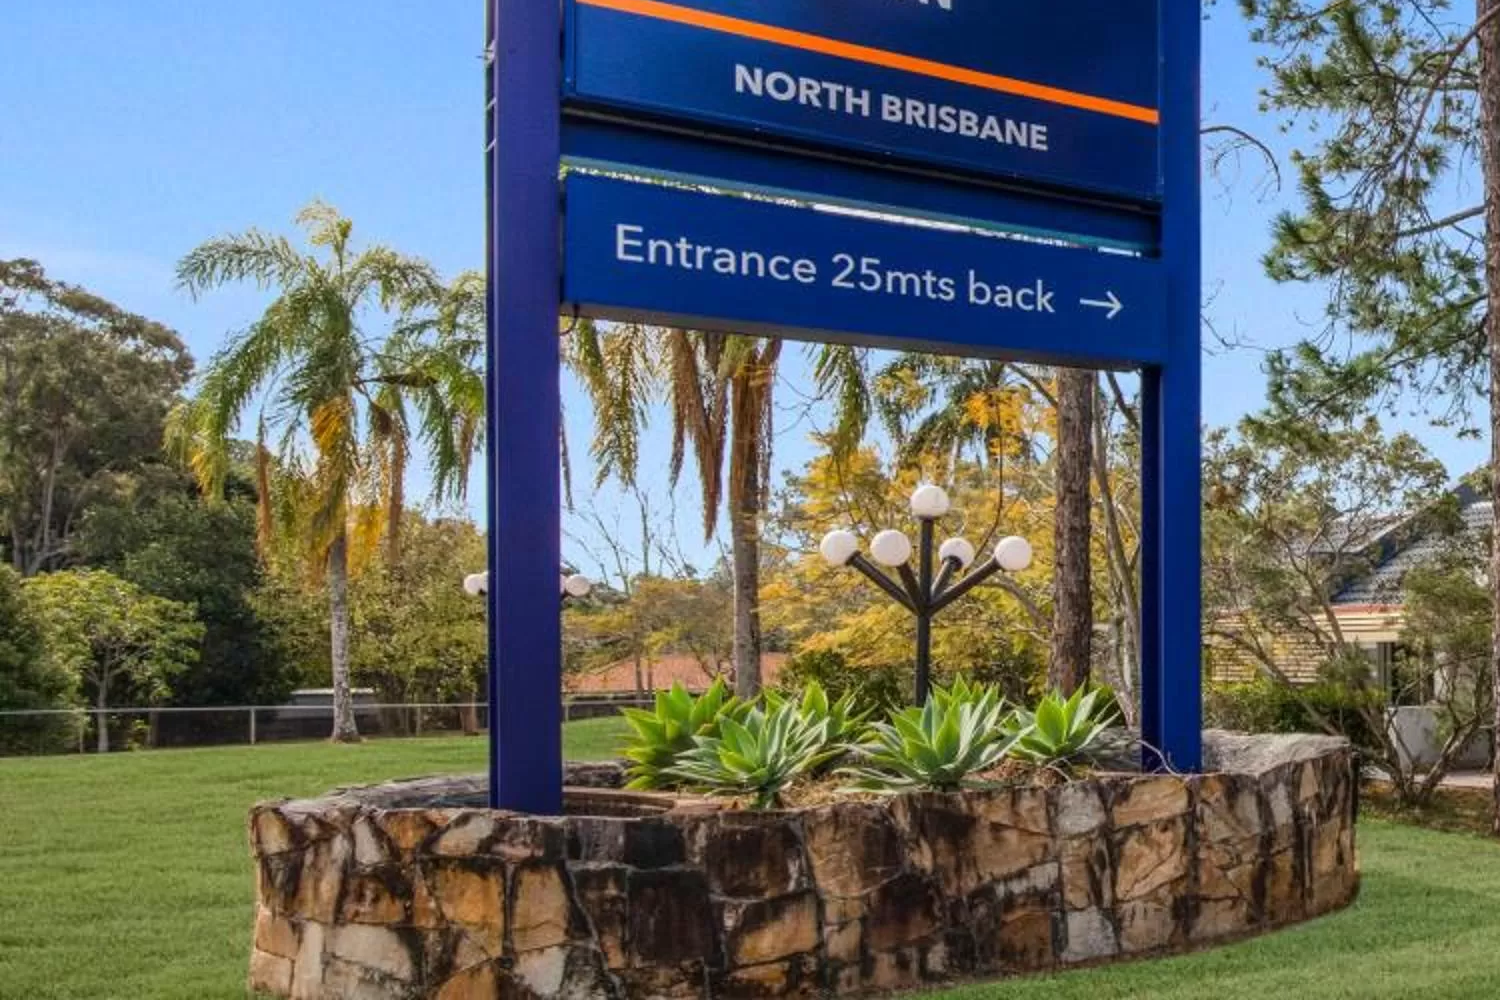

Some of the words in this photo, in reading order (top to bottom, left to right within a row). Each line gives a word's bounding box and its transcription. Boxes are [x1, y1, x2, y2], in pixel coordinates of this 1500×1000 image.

[734, 64, 871, 118] NORTH
[881, 94, 1049, 151] BRISBANE
[616, 223, 817, 283] Entrance
[831, 253, 956, 301] 25mts
[968, 270, 1055, 313] back
